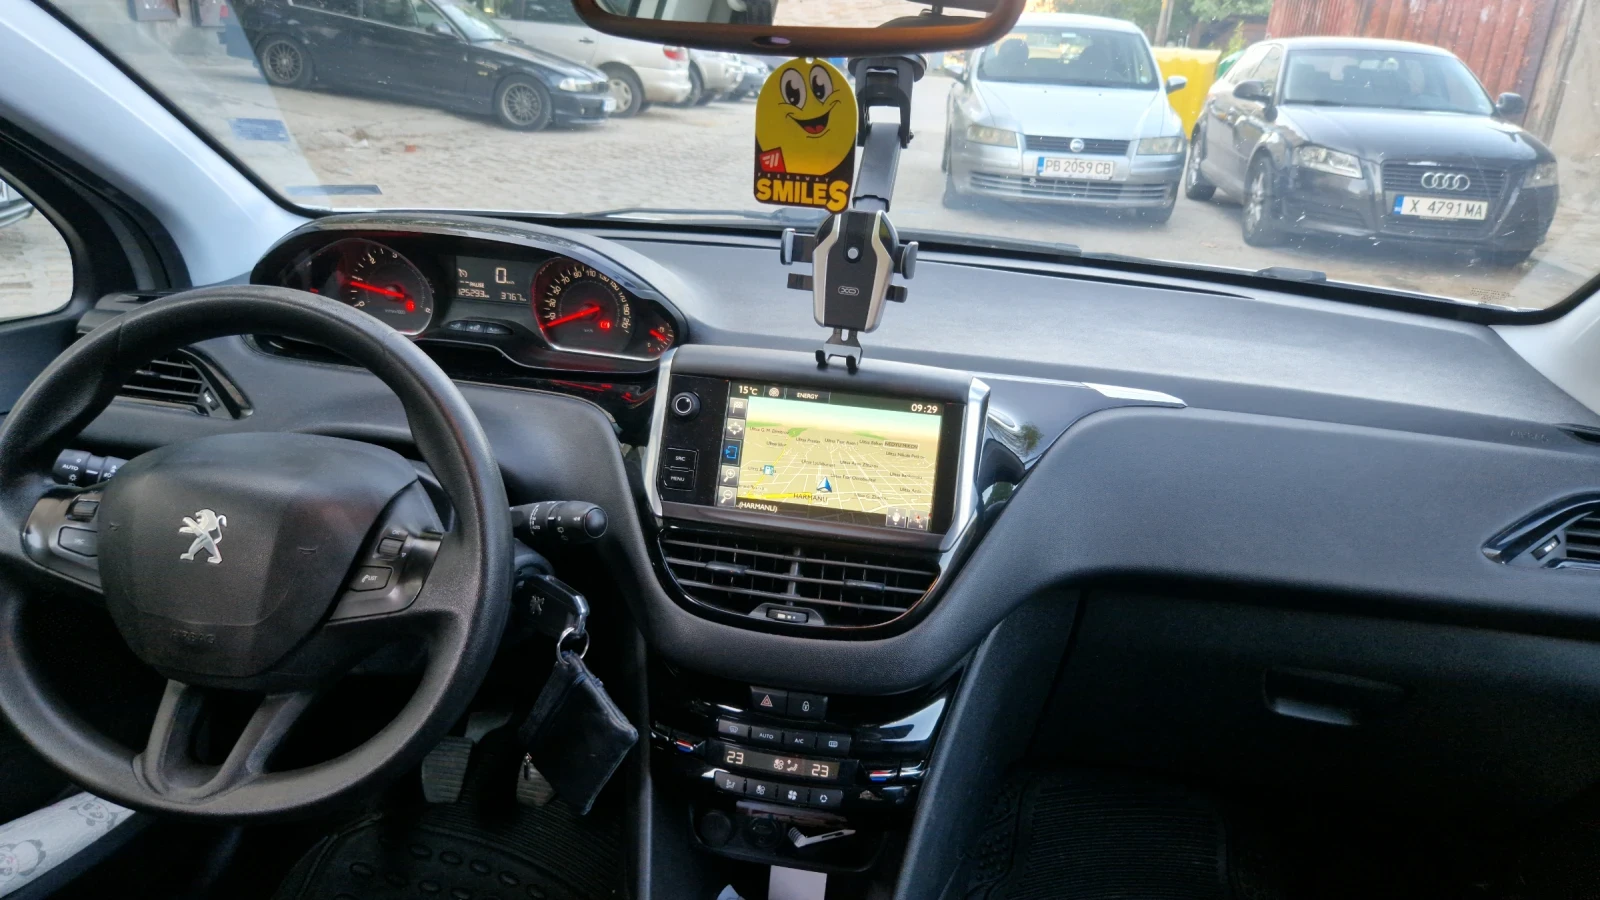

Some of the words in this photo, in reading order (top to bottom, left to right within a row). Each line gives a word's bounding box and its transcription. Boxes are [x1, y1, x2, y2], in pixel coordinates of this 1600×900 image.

[1045, 159, 1060, 172] PB
[1063, 161, 1093, 174] 2059
[1095, 162, 1111, 175] CB
[756, 178, 849, 212] SMILES
[1410, 199, 1420, 213] X
[1427, 200, 1462, 216] 4791
[1464, 203, 1482, 218] MA
[496, 267, 507, 284] 0
[796, 392, 819, 400] ENERGY
[910, 403, 938, 414] 09:29
[759, 732, 774, 740] AUTO
[726, 750, 744, 765] 23
[811, 763, 829, 778] 23
